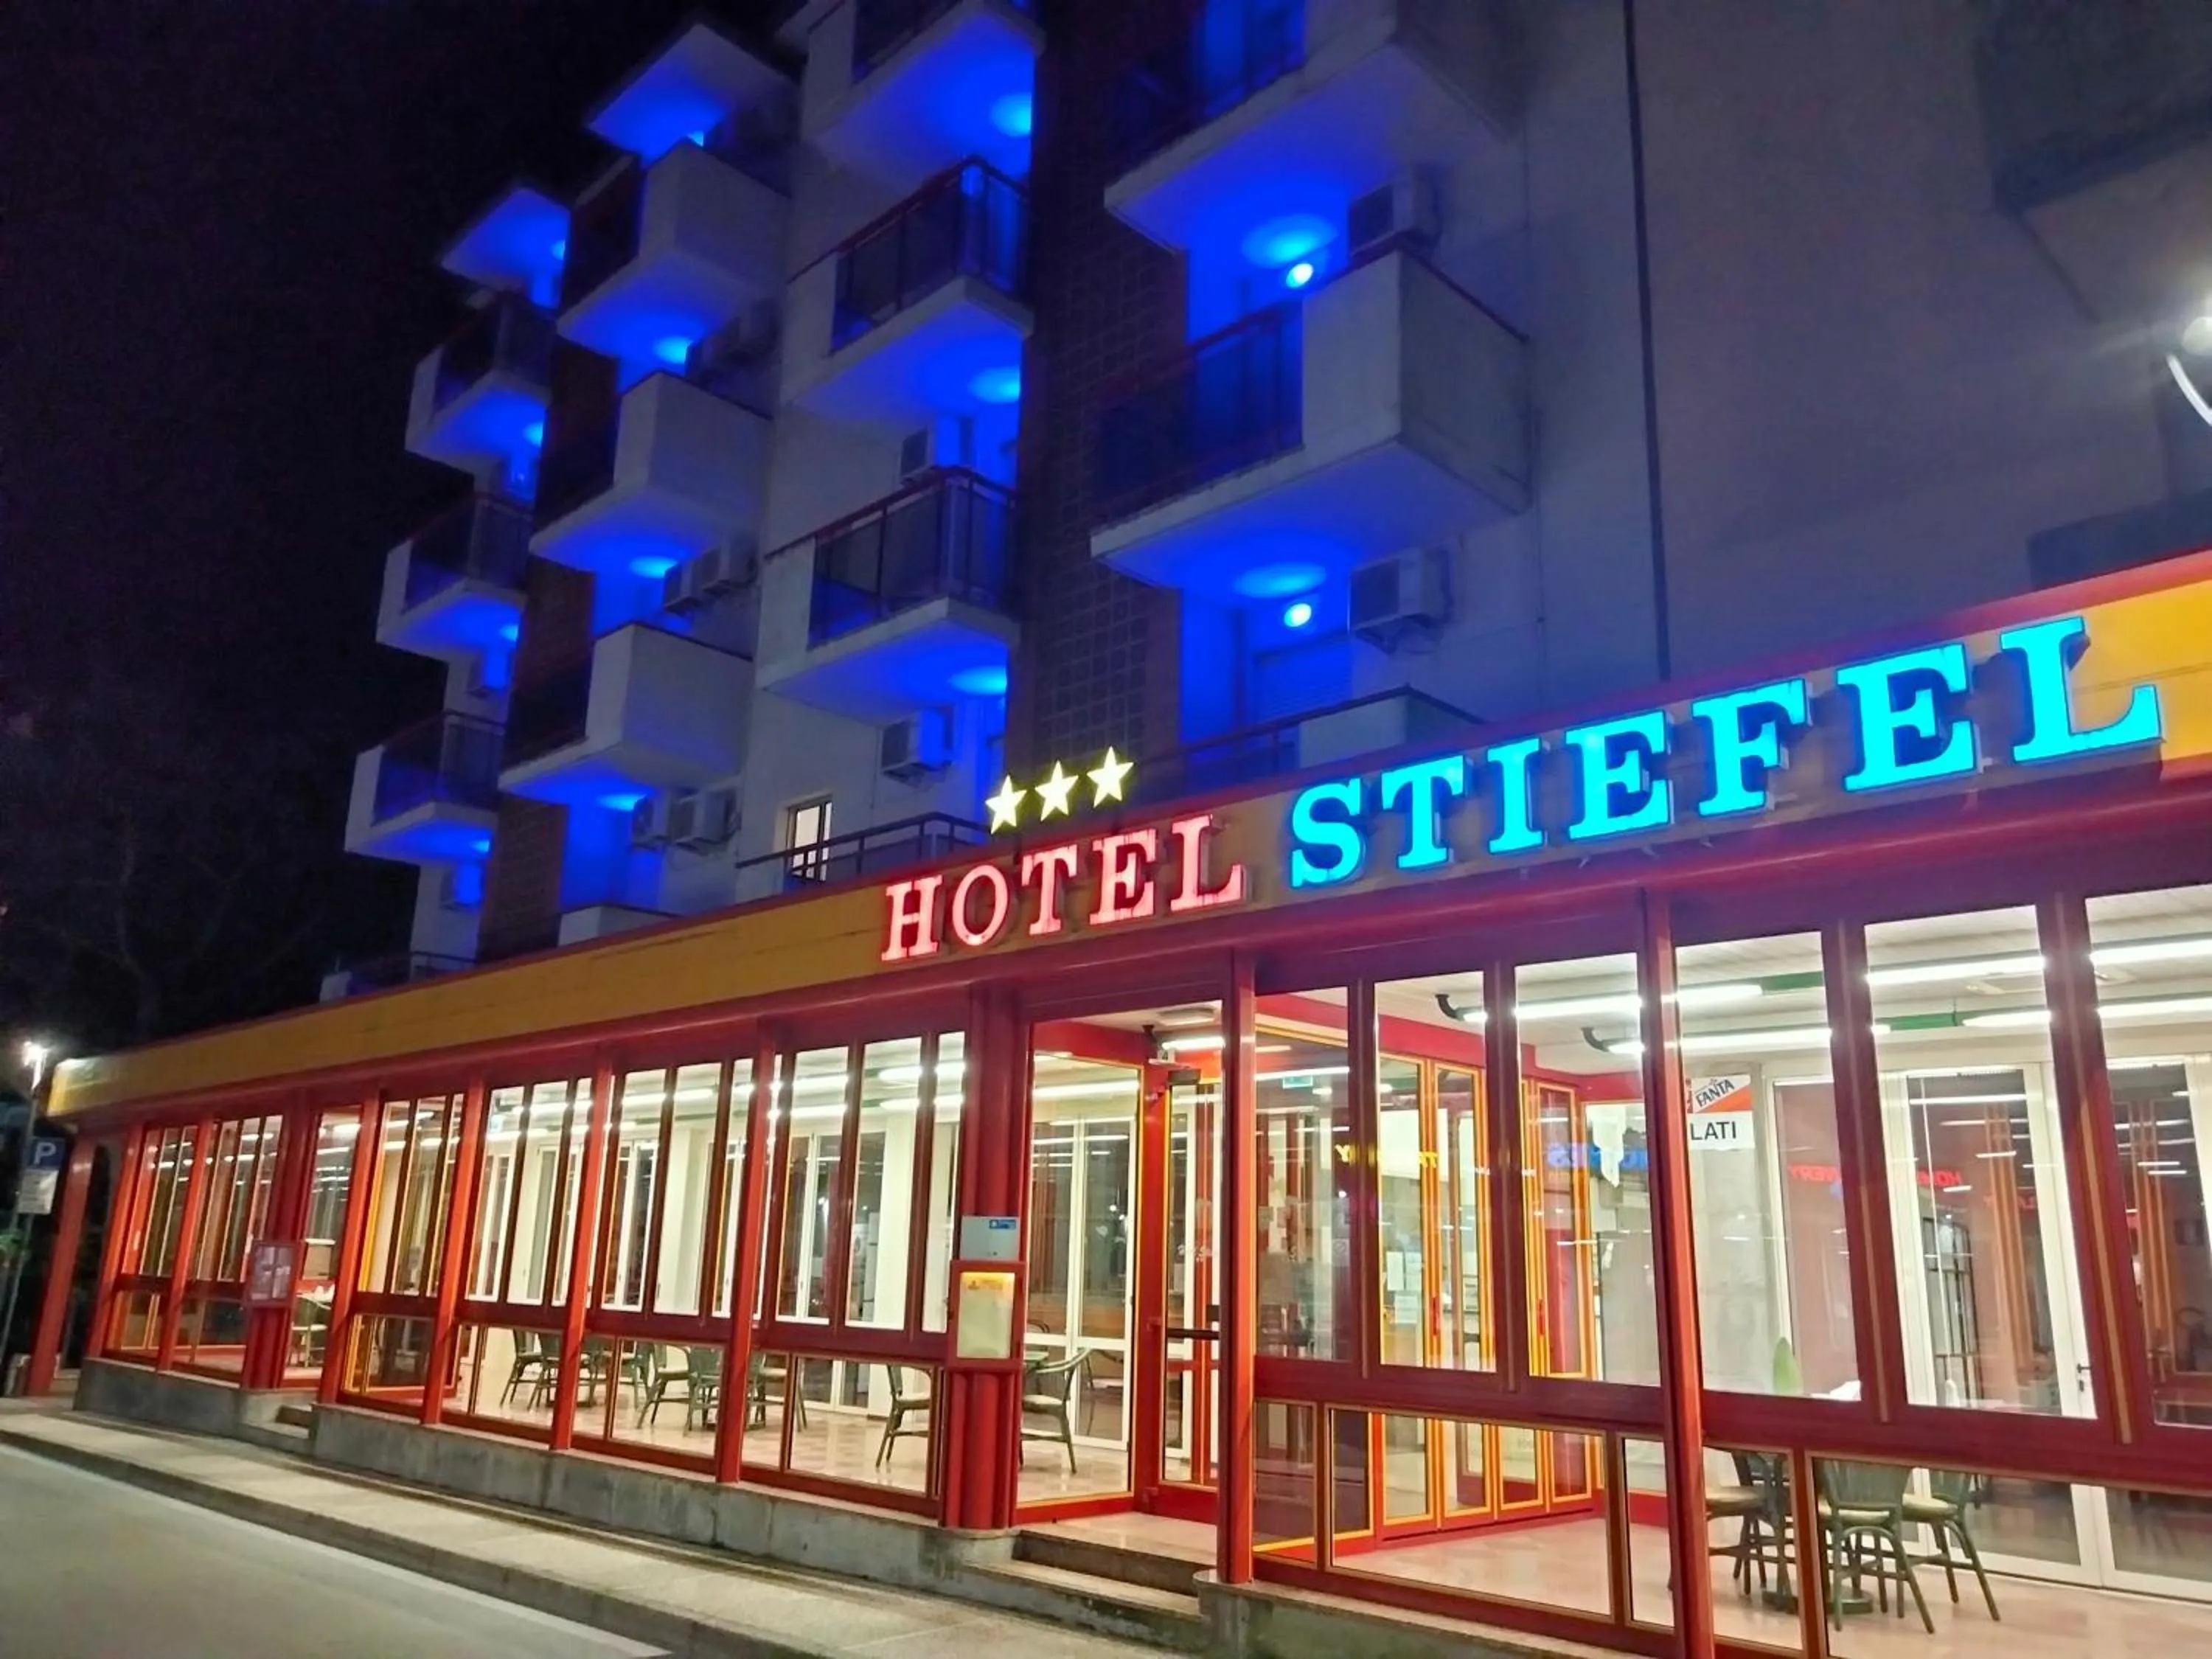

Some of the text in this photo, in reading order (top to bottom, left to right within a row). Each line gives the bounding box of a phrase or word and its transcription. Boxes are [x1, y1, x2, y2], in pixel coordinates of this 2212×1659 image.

[881, 615, 2163, 961] HOTEL STIEFEL
[1696, 1079, 1735, 1107] FANTA
[1690, 1121, 1736, 1141] LATI
[34, 1141, 58, 1164] P
